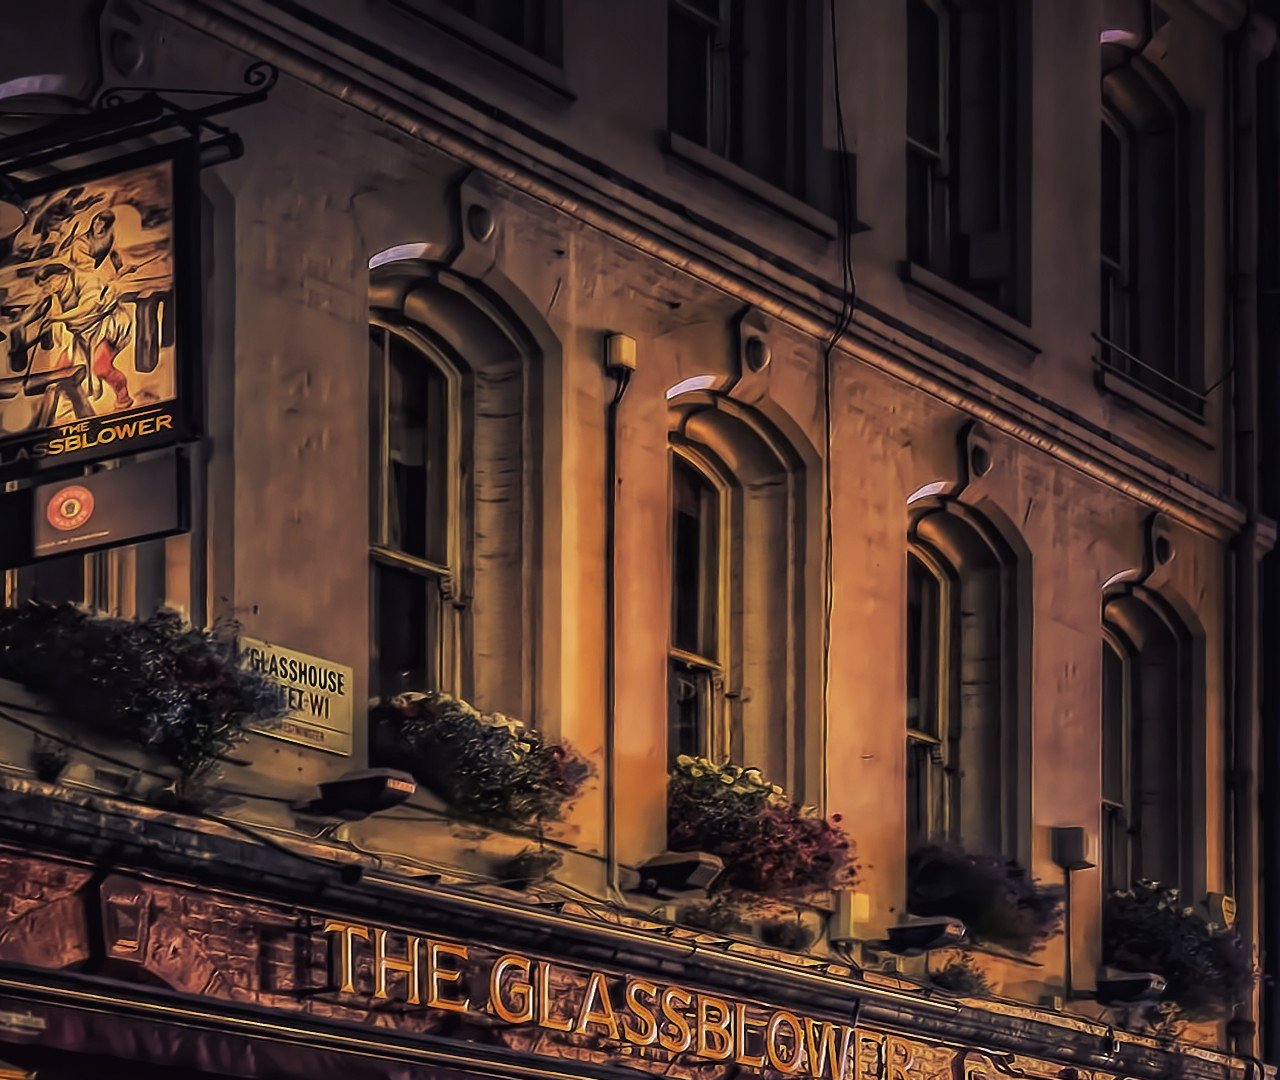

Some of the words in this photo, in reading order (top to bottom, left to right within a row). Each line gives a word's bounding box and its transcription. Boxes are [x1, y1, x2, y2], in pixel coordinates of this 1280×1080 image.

[60, 421, 90, 436] THE
[249, 648, 345, 696] GLASSHOUSE
[324, 919, 470, 1012] THE
